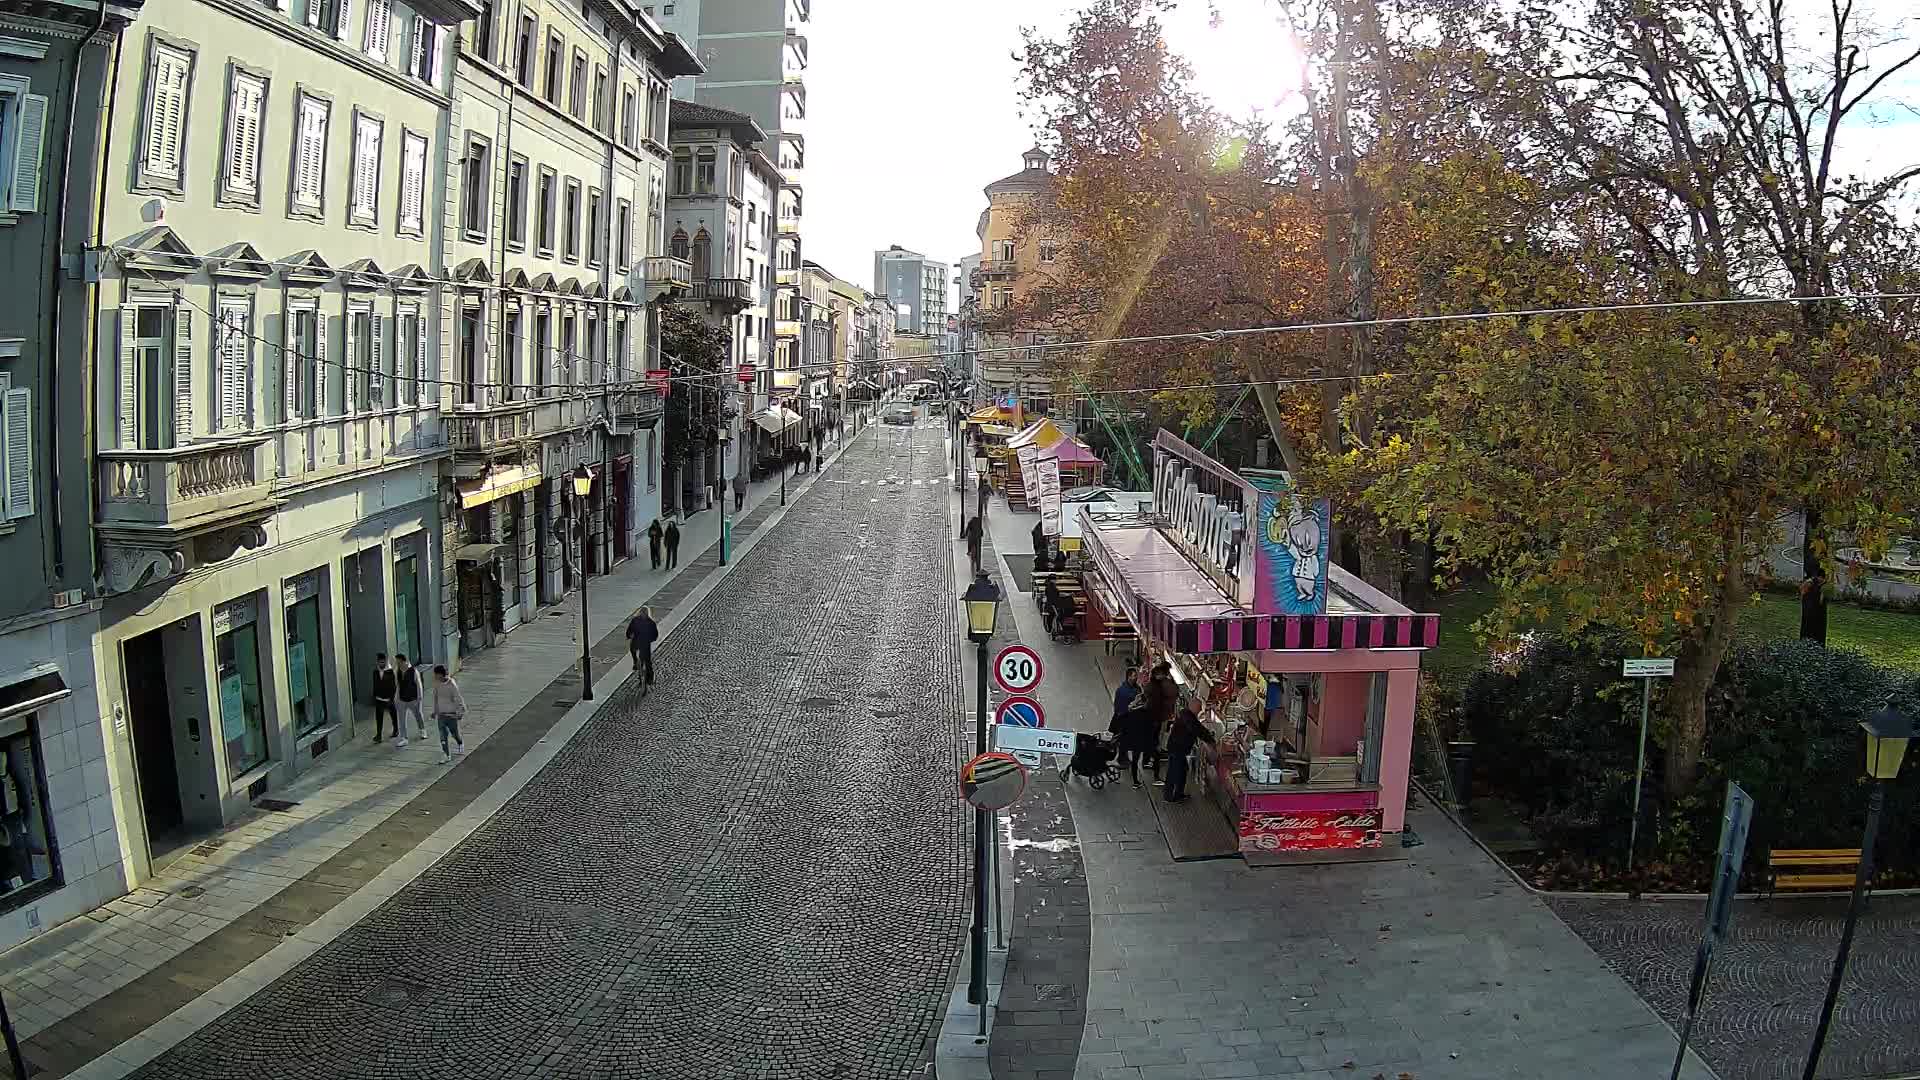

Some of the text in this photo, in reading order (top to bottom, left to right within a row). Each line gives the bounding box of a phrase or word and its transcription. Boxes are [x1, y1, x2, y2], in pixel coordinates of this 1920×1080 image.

[1005, 659, 1033, 681] 30
[1038, 738, 1070, 750] Dante
[1255, 815, 1376, 830] Frittelle Calde
